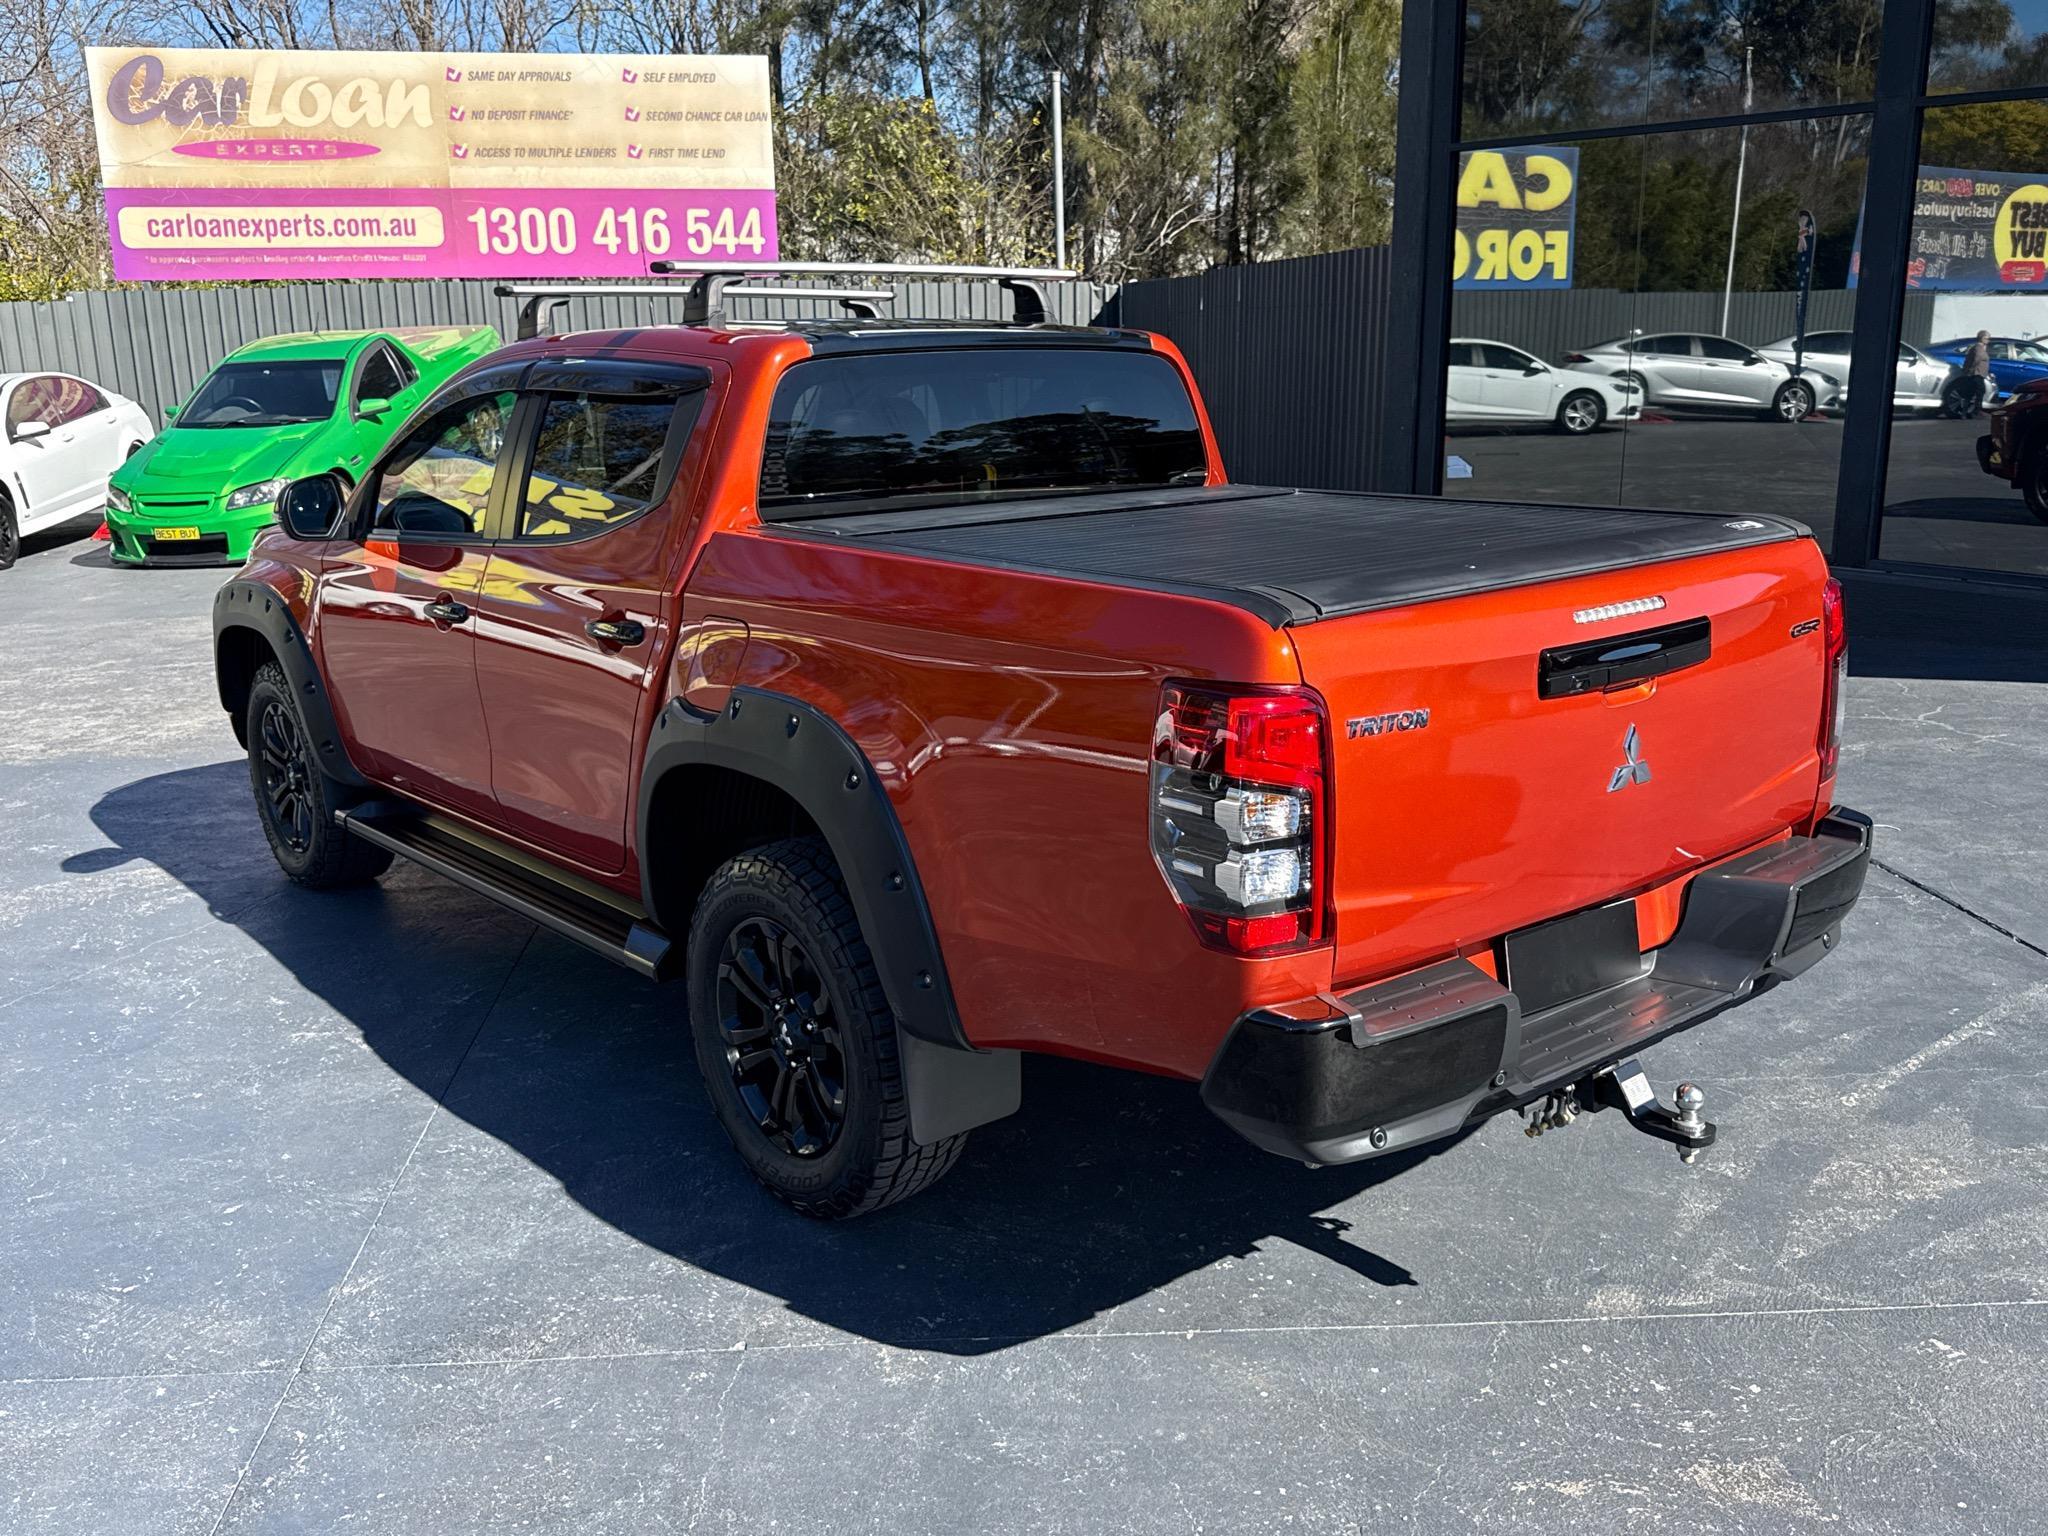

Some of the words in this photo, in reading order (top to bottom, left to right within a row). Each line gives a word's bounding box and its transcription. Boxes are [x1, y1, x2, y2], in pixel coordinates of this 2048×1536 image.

[468, 71, 495, 82] SAME
[497, 71, 516, 82] DAY
[518, 71, 572, 82] APPROVALS
[643, 72, 666, 83] SELF
[668, 72, 716, 83] EMPLOYED
[471, 110, 485, 121] NO
[487, 110, 527, 121] DEPOSIT
[646, 111, 683, 122] SECOND
[685, 111, 722, 122] CHANCE
[724, 111, 743, 122] CAR
[745, 111, 768, 122] LOAN
[216, 143, 337, 156] EXPERTS
[474, 147, 511, 158] ACCESS
[514, 147, 526, 158] TO
[528, 147, 572, 158] MULTIPLE
[575, 147, 617, 158] LENDERS
[648, 148, 675, 159] FIRST
[677, 148, 699, 159] TIME
[702, 148, 726, 159] LEND
[147, 213, 417, 243] carloanexperts.com.au
[467, 207, 577, 255] 1300
[592, 207, 671, 255] 416
[686, 207, 766, 255] 544
[156, 529, 177, 539] BEST
[179, 529, 197, 538] BUY
[1790, 618, 1821, 638] GSR
[1346, 709, 1430, 740] TRITON
